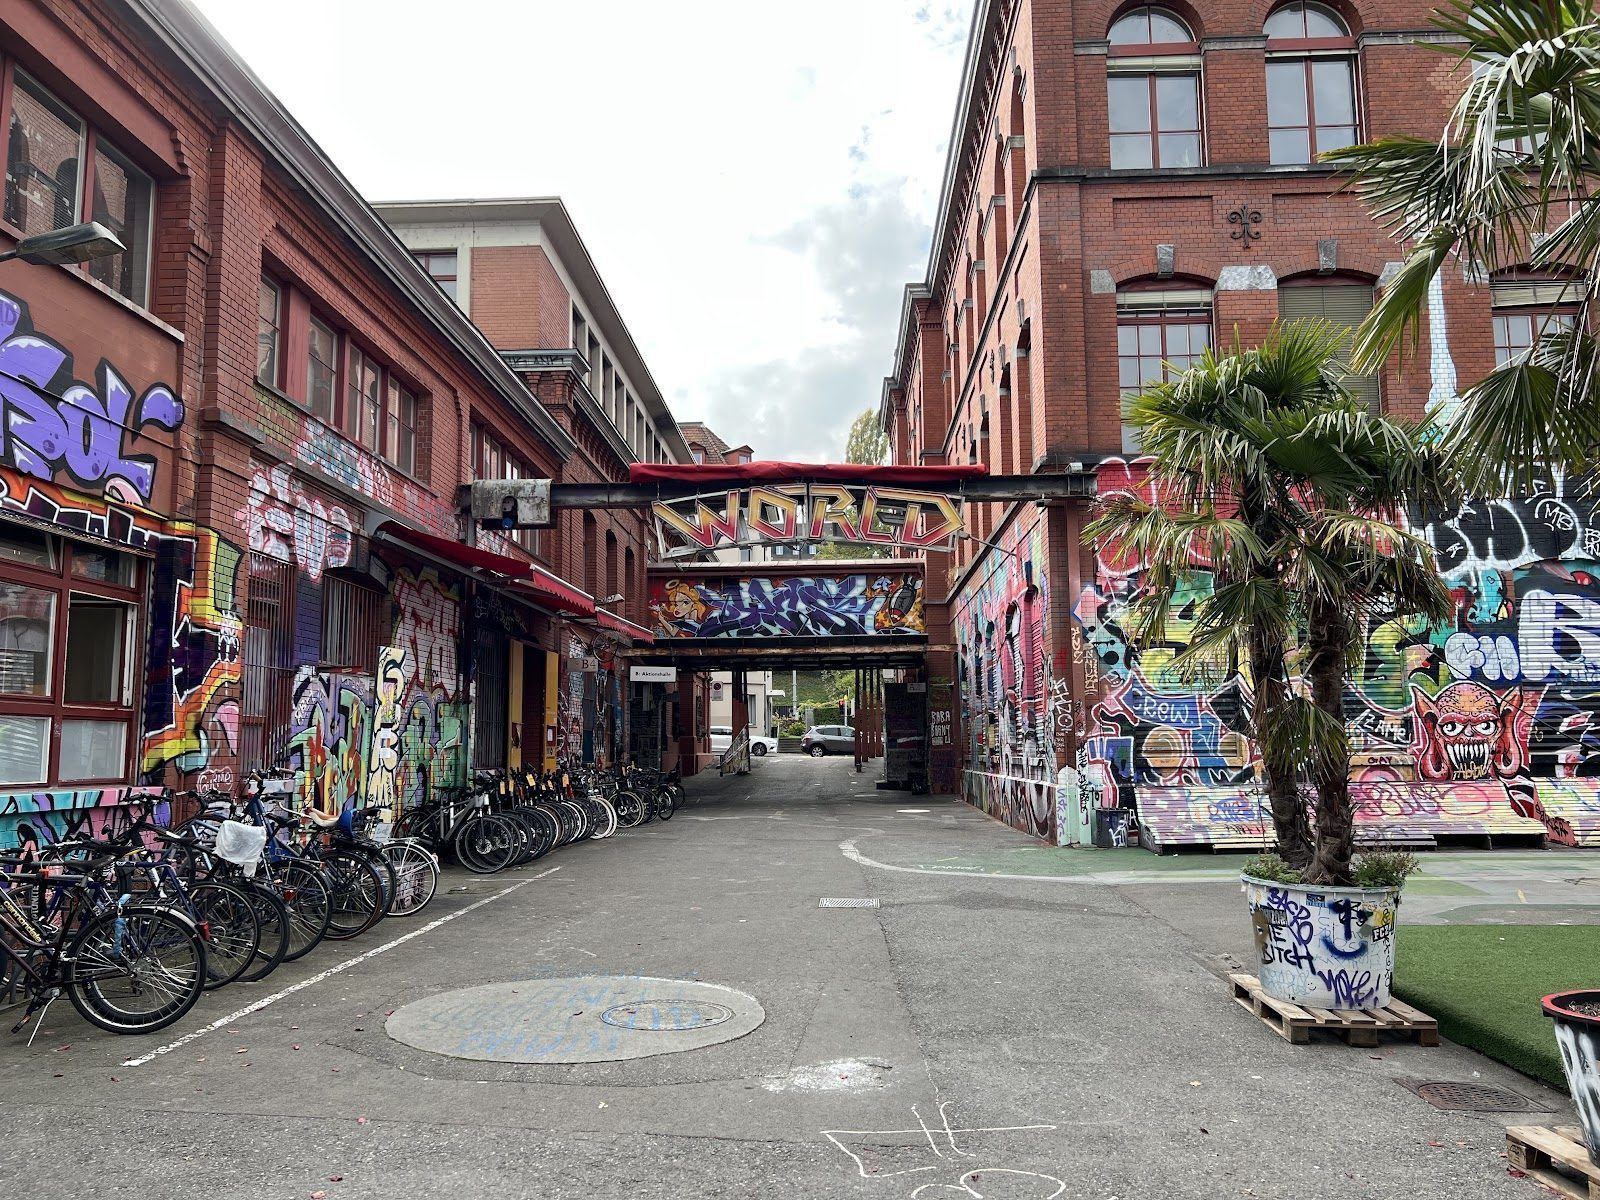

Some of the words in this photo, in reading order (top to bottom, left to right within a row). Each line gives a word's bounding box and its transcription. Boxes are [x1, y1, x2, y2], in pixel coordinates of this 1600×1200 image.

[652, 483, 965, 548] WORLD
[581, 659, 596, 669] B4
[1367, 756, 1393, 764] GAY
[3, 900, 42, 943] cannondale
